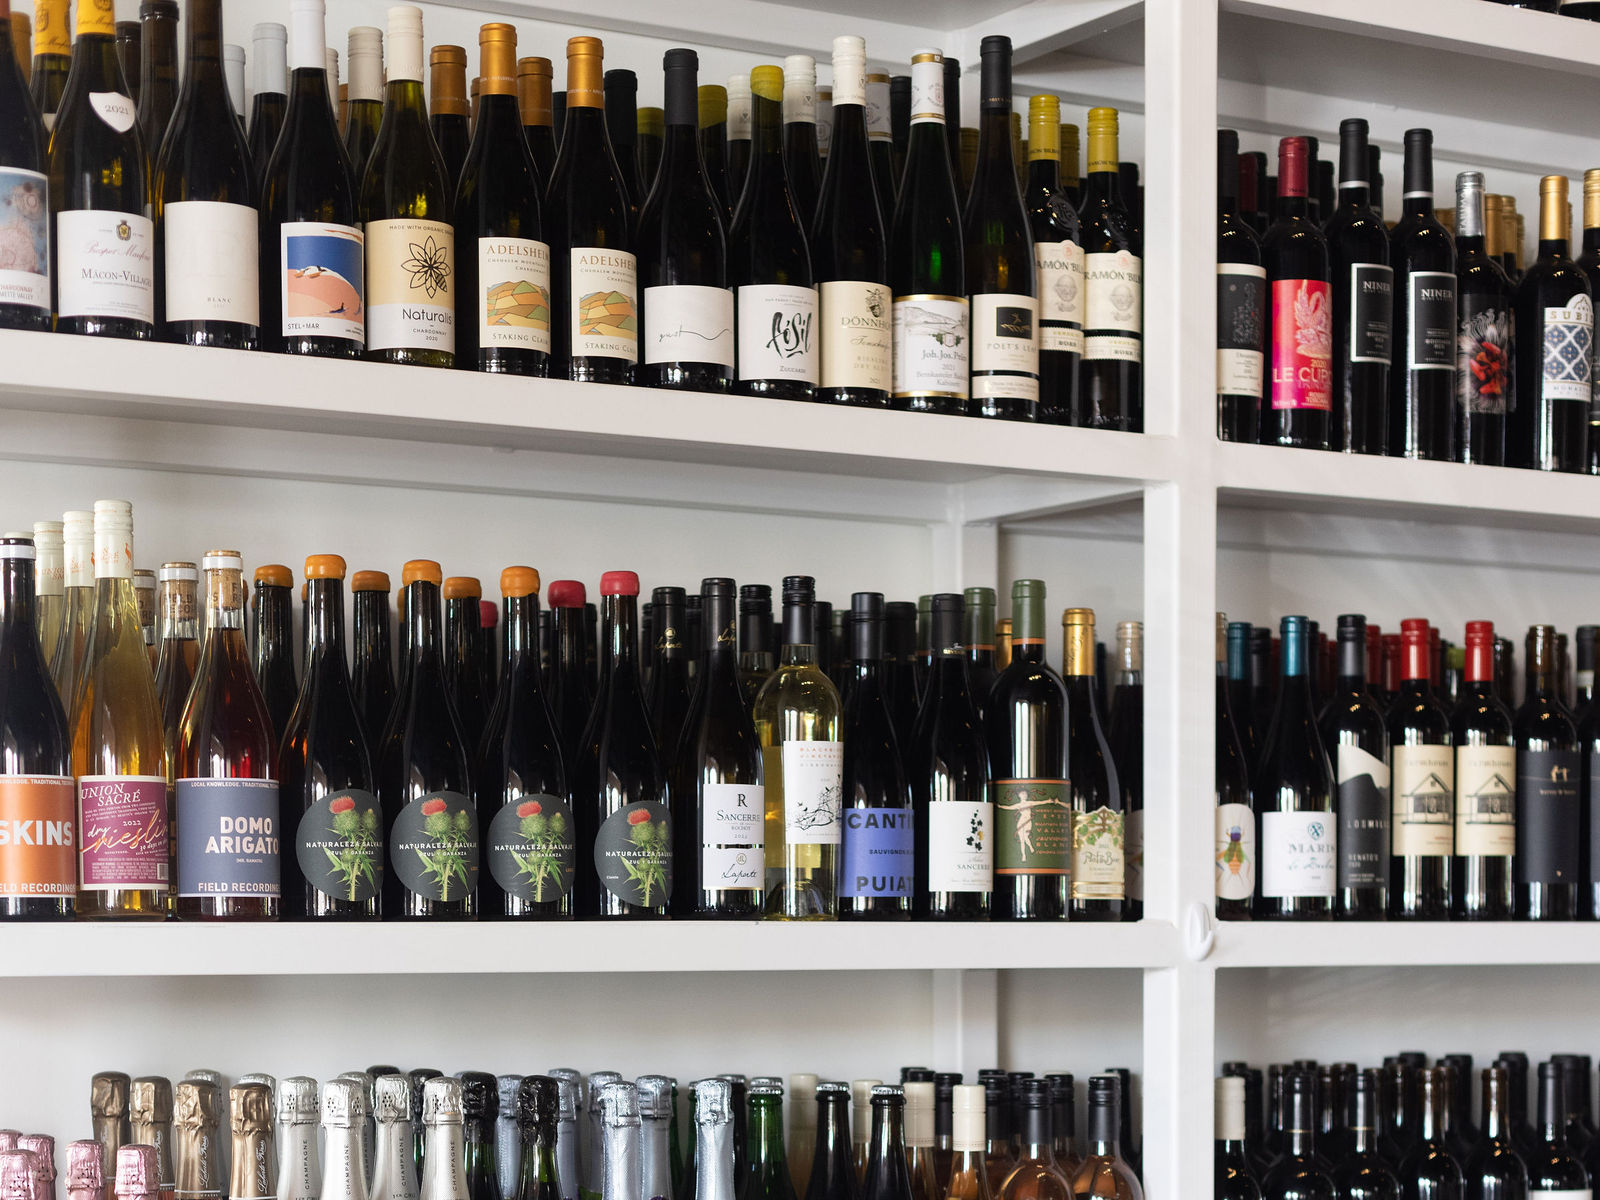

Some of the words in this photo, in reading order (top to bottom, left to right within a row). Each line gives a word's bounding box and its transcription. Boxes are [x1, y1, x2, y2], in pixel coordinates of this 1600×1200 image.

[105, 104, 129, 115] 2021
[1036, 260, 1068, 271] AMÓN
[492, 332, 529, 342] STAKING
[1272, 366, 1294, 383] LE
[81, 783, 126, 800] UNION
[97, 788, 142, 807] SACRÉ
[737, 793, 748, 808] R
[716, 810, 761, 822] SANCERRE
[80, 808, 168, 853] rieslin
[220, 816, 273, 835] DOMO
[205, 836, 279, 855] ARIGATO
[305, 841, 359, 849] NATURALEZA
[399, 841, 452, 850] NATURALEZA
[494, 843, 547, 851] NATURALEZA
[605, 850, 656, 858] NATURALEZA
[198, 882, 228, 893] FIELD
